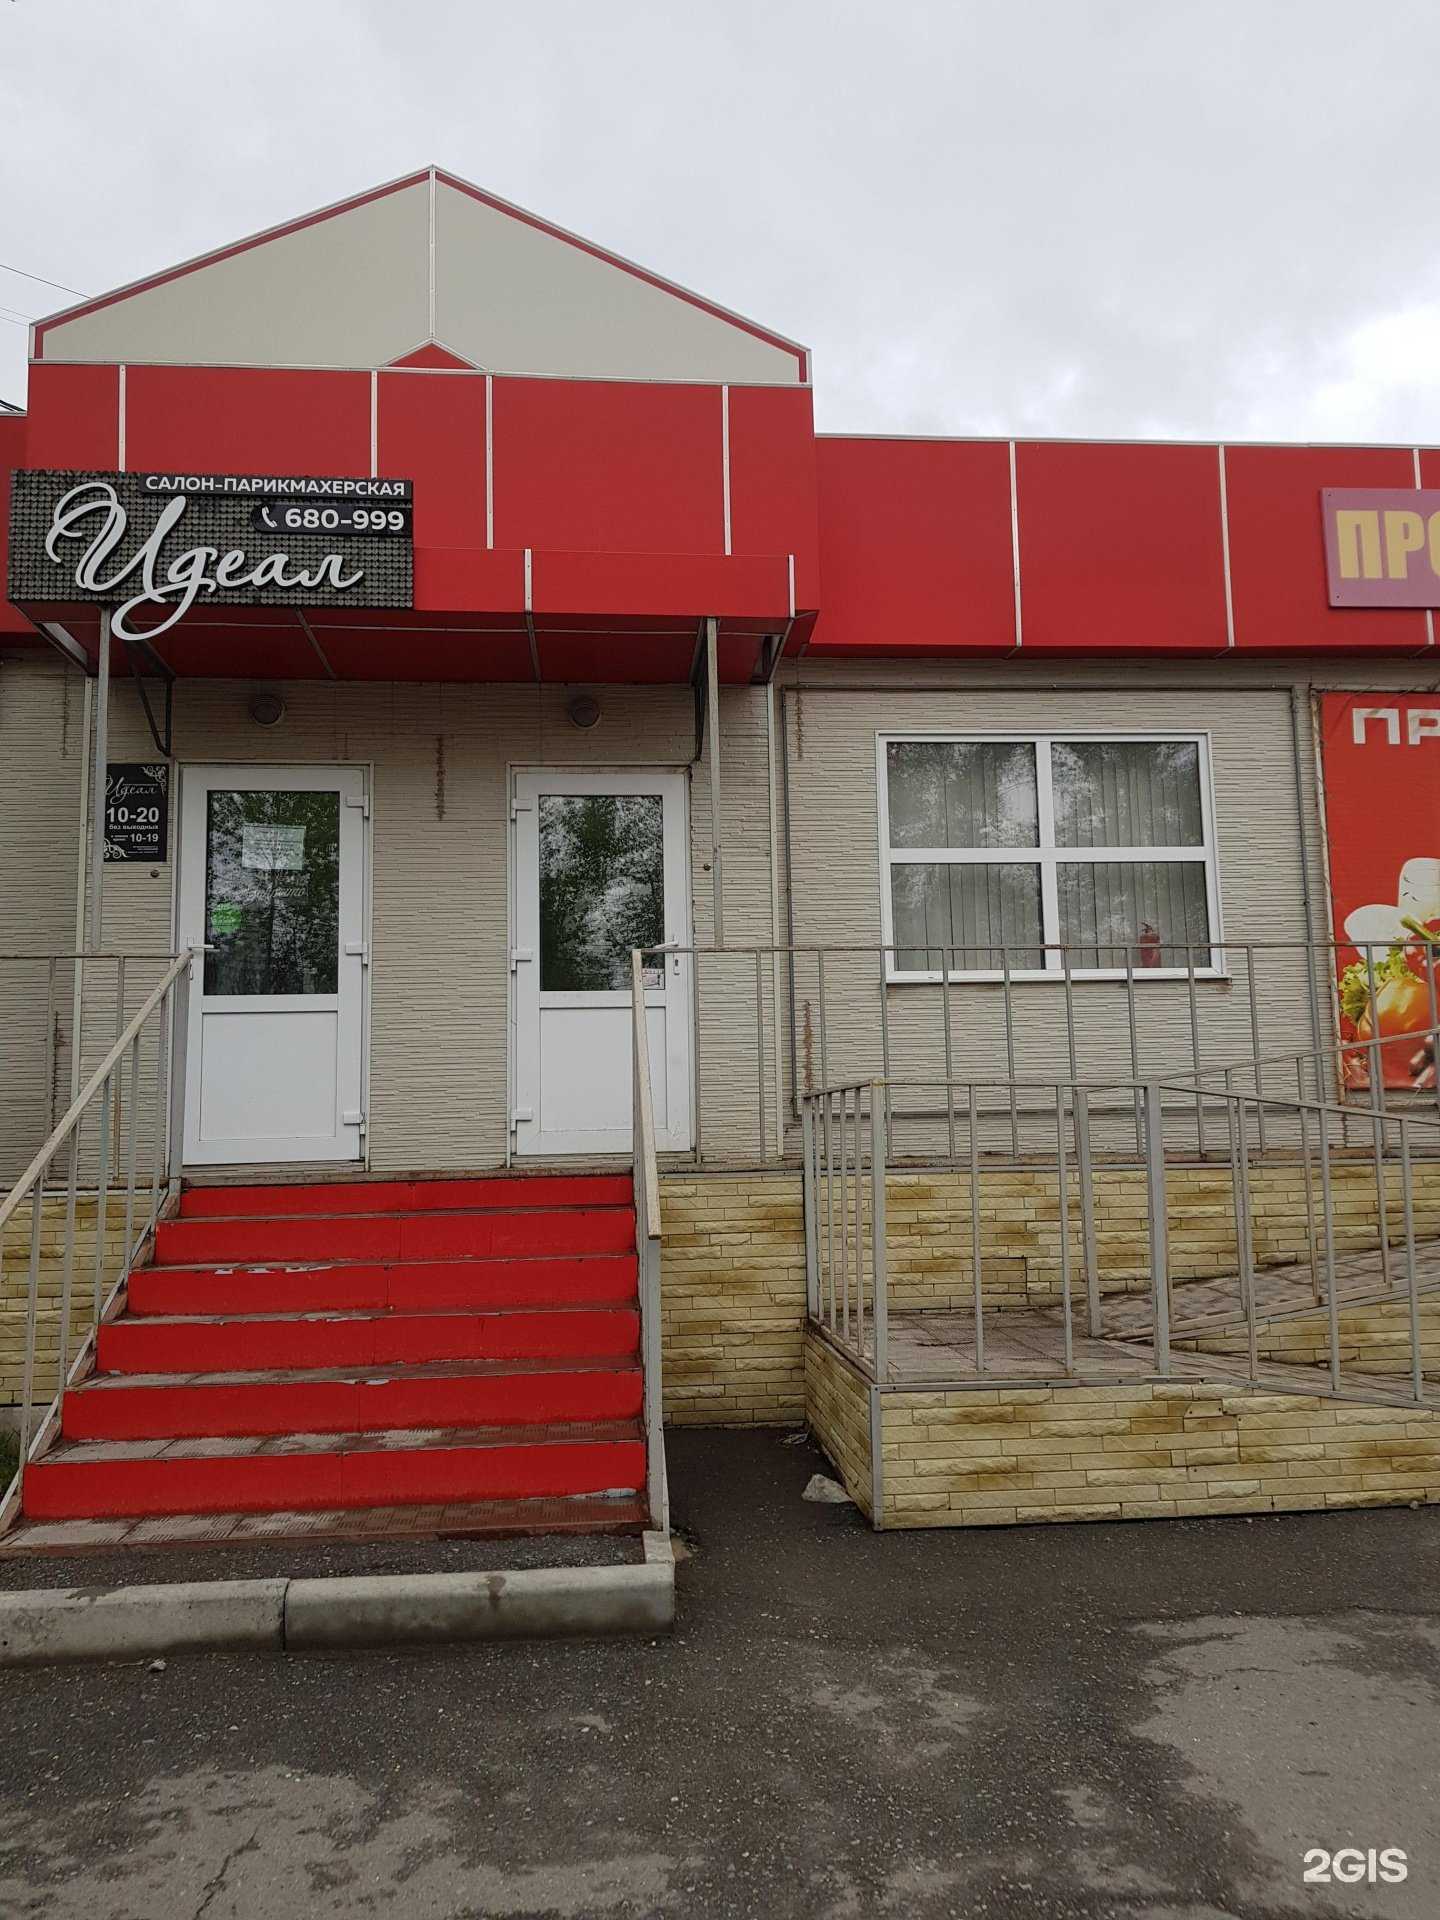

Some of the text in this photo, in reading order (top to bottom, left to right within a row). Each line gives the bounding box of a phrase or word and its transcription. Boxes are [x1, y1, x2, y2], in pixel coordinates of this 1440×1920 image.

[145, 476, 405, 496] САЛОН-ПАРИКМАХЕРСКАЯ
[284, 508, 405, 531] 680-999
[45, 482, 364, 641] Идеал
[106, 806, 160, 824] 10-20
[130, 832, 159, 843] 10-19
